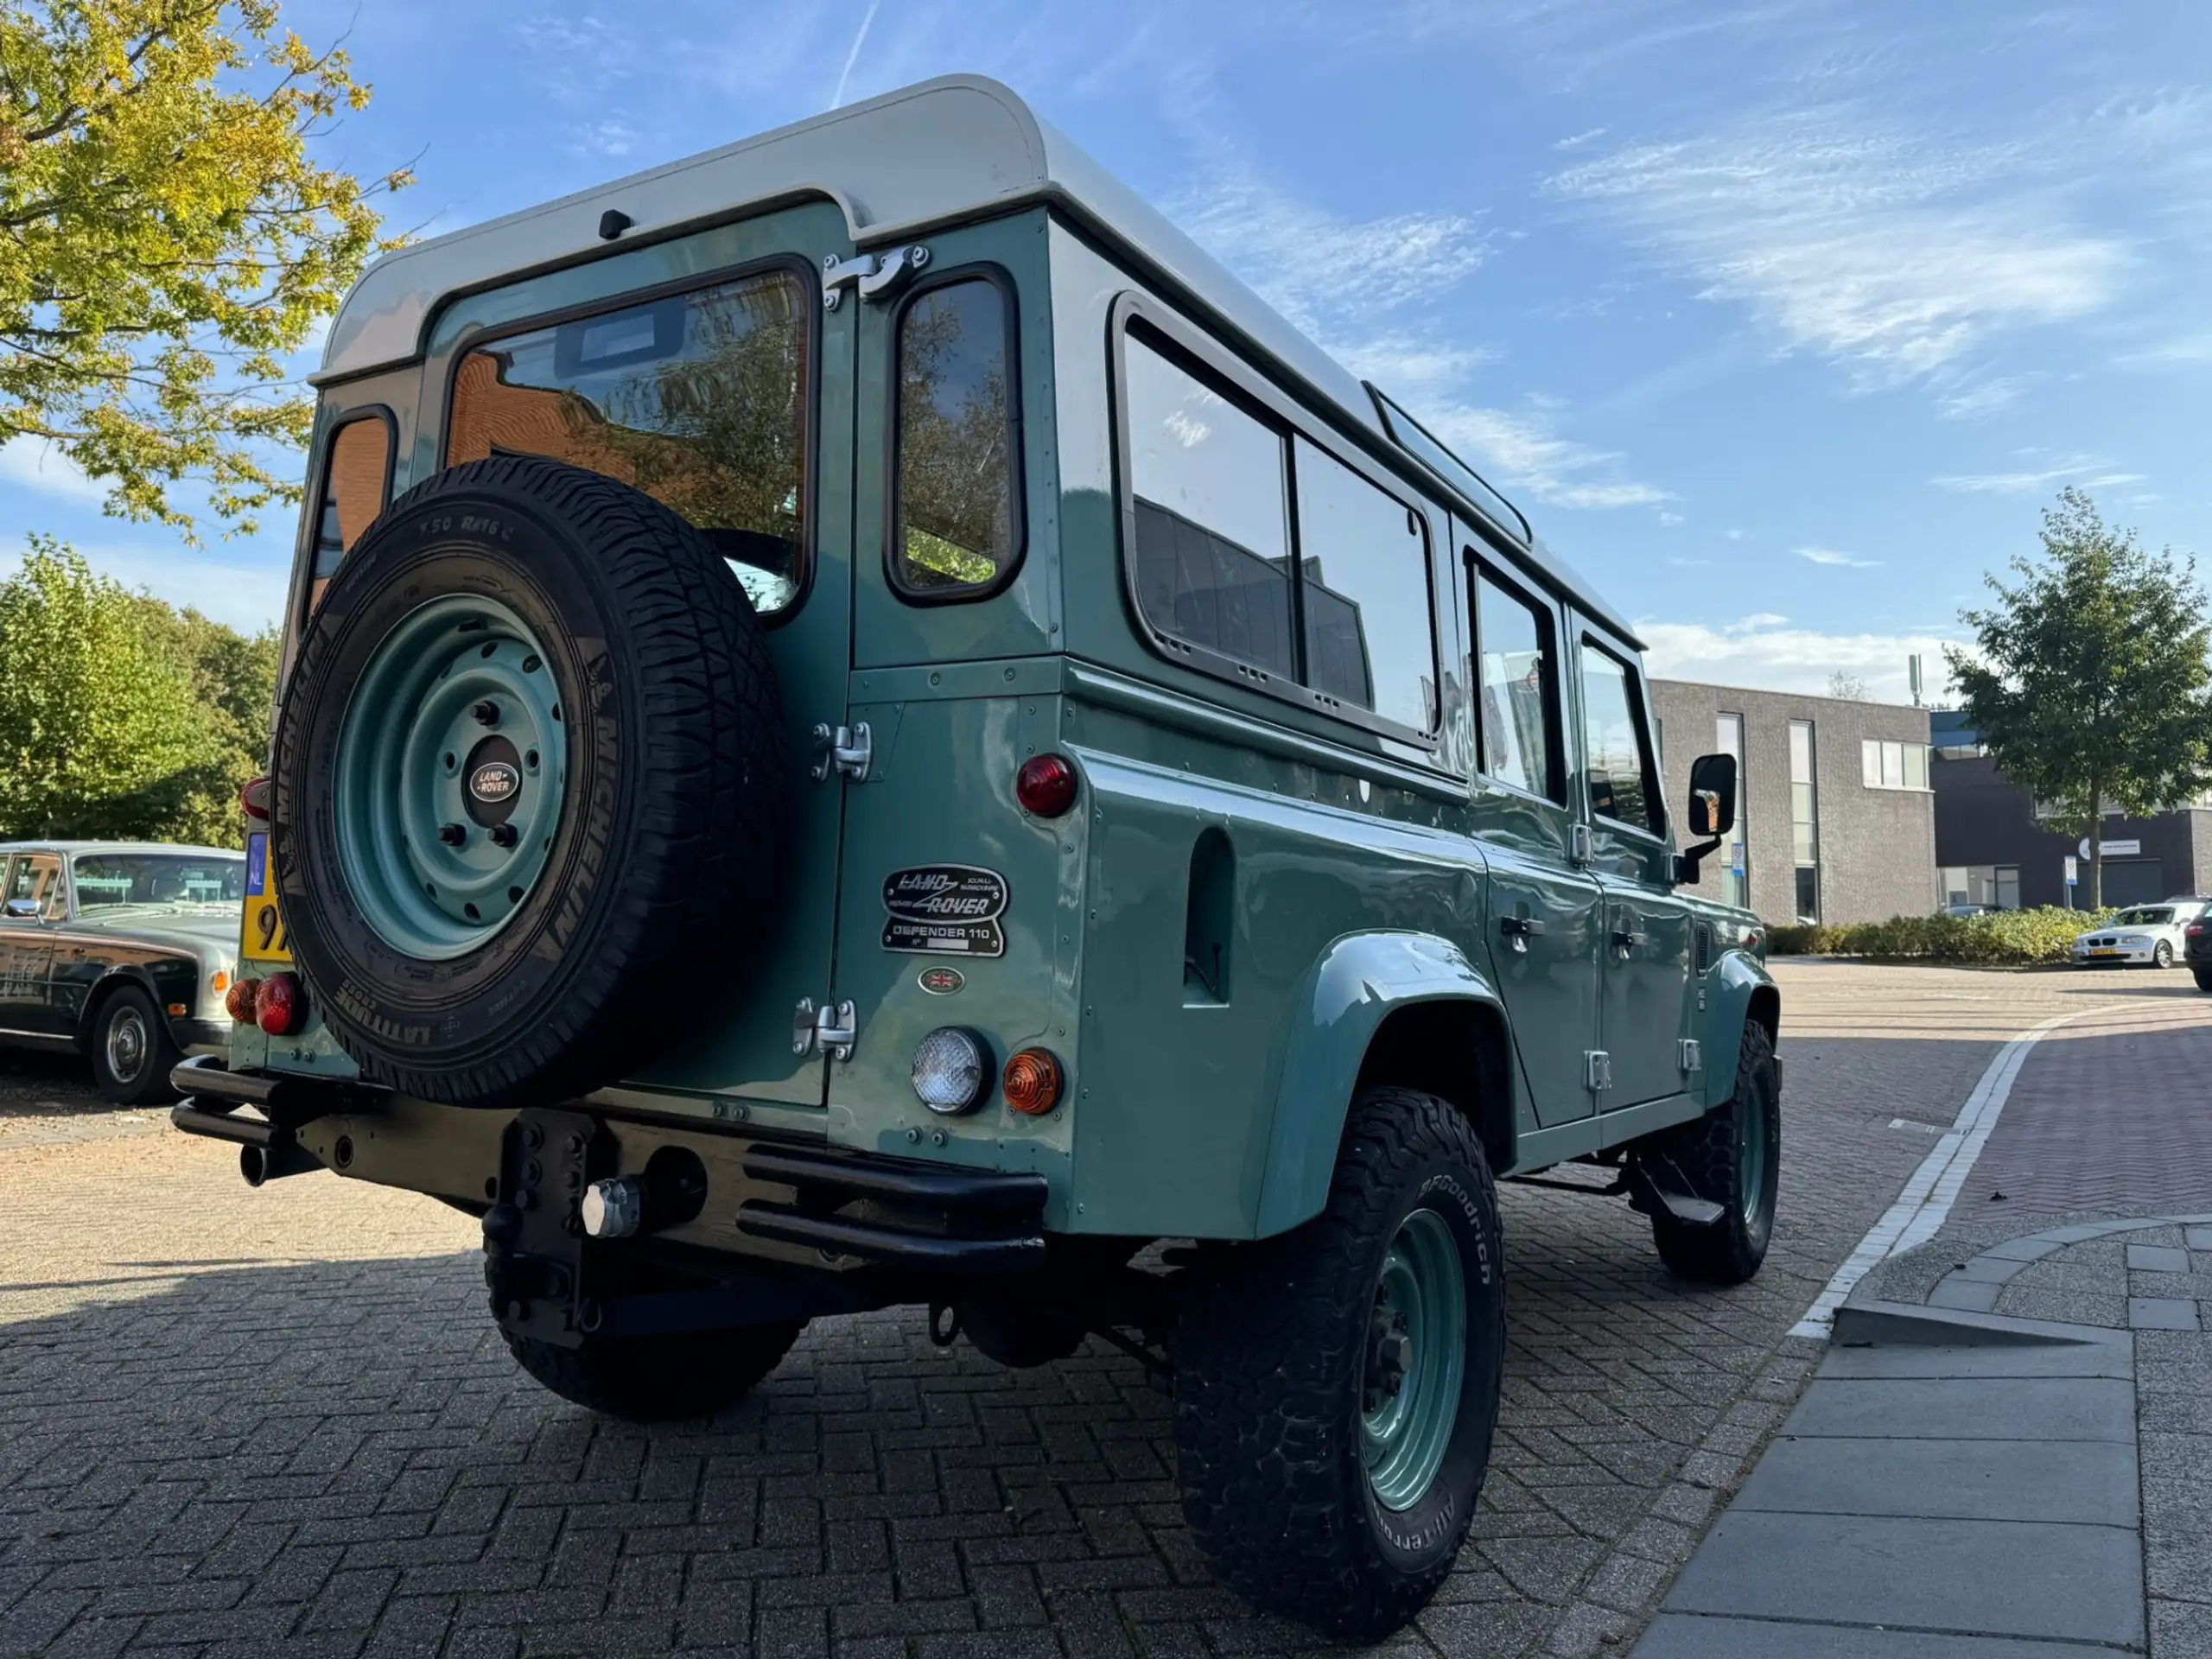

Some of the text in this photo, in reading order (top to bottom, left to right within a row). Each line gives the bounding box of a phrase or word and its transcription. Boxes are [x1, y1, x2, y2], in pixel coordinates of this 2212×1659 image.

[276, 630, 328, 824] MICHELIN
[480, 771, 503, 782] LAND
[480, 781, 511, 793] ROVER
[554, 715, 619, 944] MICHELIN
[249, 873, 263, 886] NL
[898, 874, 949, 890] LAND
[926, 897, 989, 915] ROVER
[893, 925, 990, 939] DEFENDER 110
[342, 979, 377, 1009] CROSS
[334, 986, 430, 1046] LATITUDE
[1415, 1174, 1492, 1286] BFGoodrich
